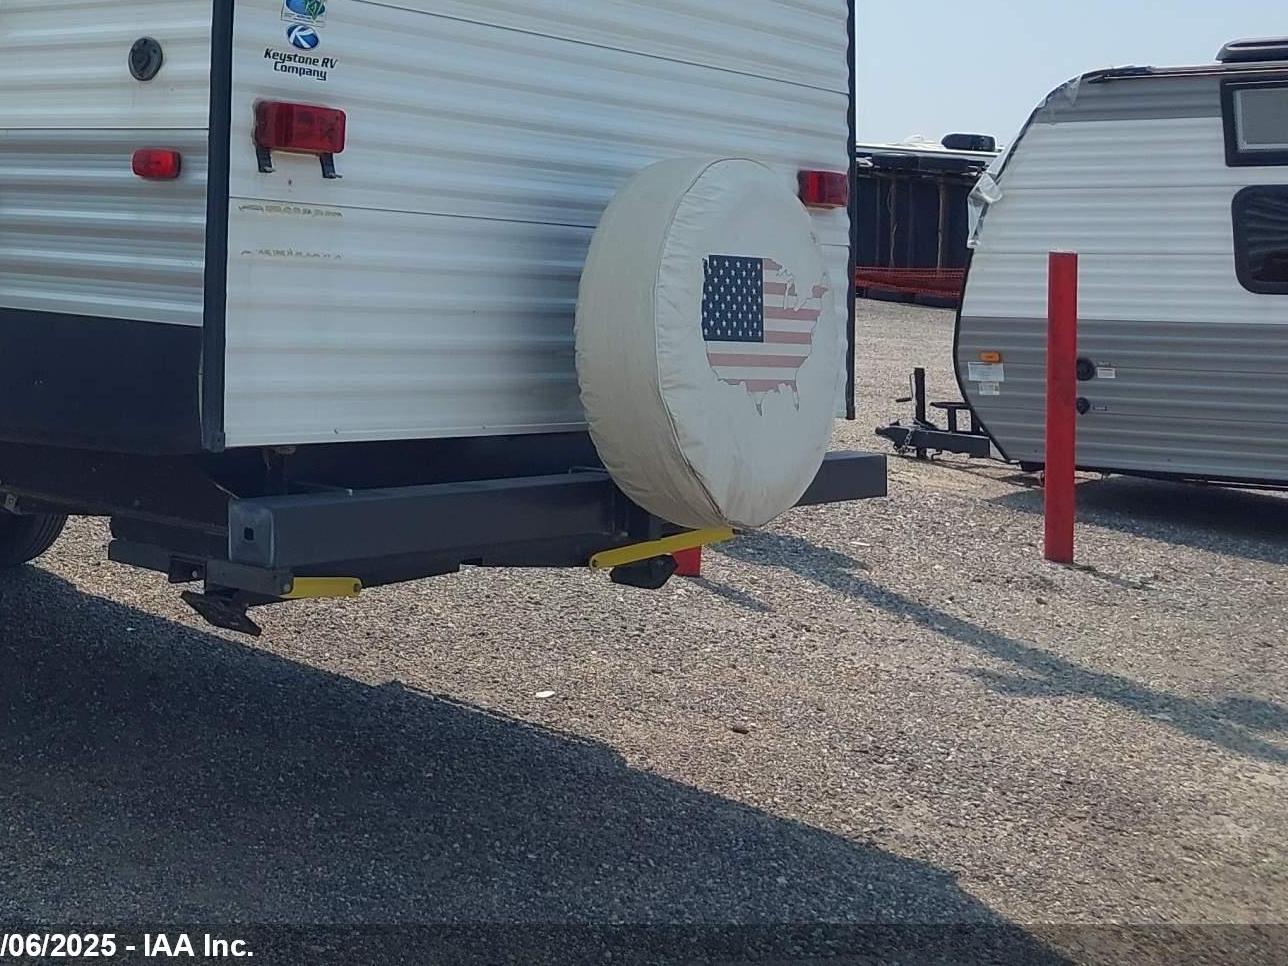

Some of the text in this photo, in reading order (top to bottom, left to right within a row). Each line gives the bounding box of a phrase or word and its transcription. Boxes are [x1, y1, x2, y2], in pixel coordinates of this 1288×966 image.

[263, 47, 339, 70] Keystone RV
[273, 60, 327, 82] Company
